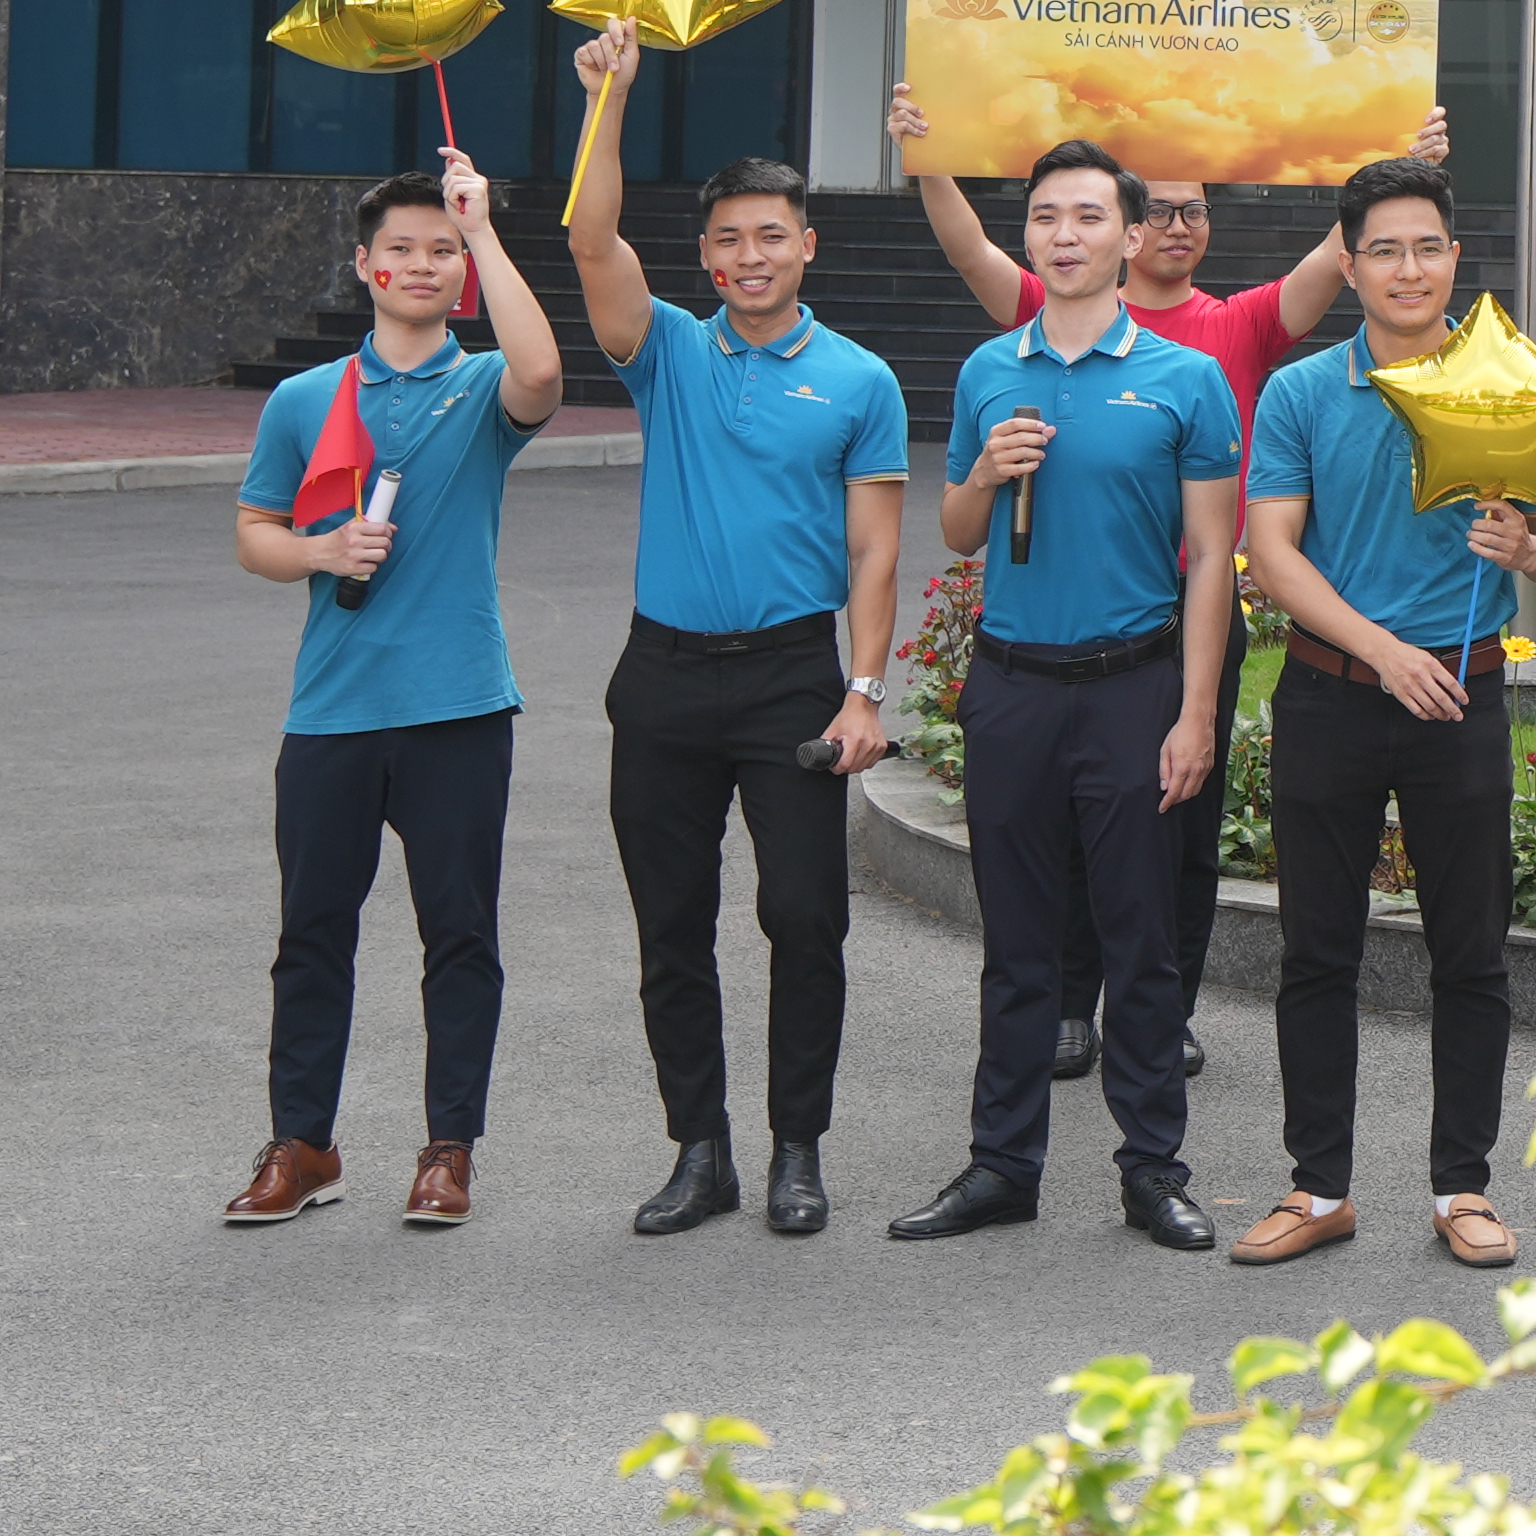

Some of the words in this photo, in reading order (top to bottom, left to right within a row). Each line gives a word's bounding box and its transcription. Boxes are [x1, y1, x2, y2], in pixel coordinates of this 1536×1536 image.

[1064, 27, 1090, 47] SẢI
[1095, 30, 1144, 49] CÁNH
[1149, 34, 1199, 50] VƯƠN
[1204, 37, 1239, 52] CAO
